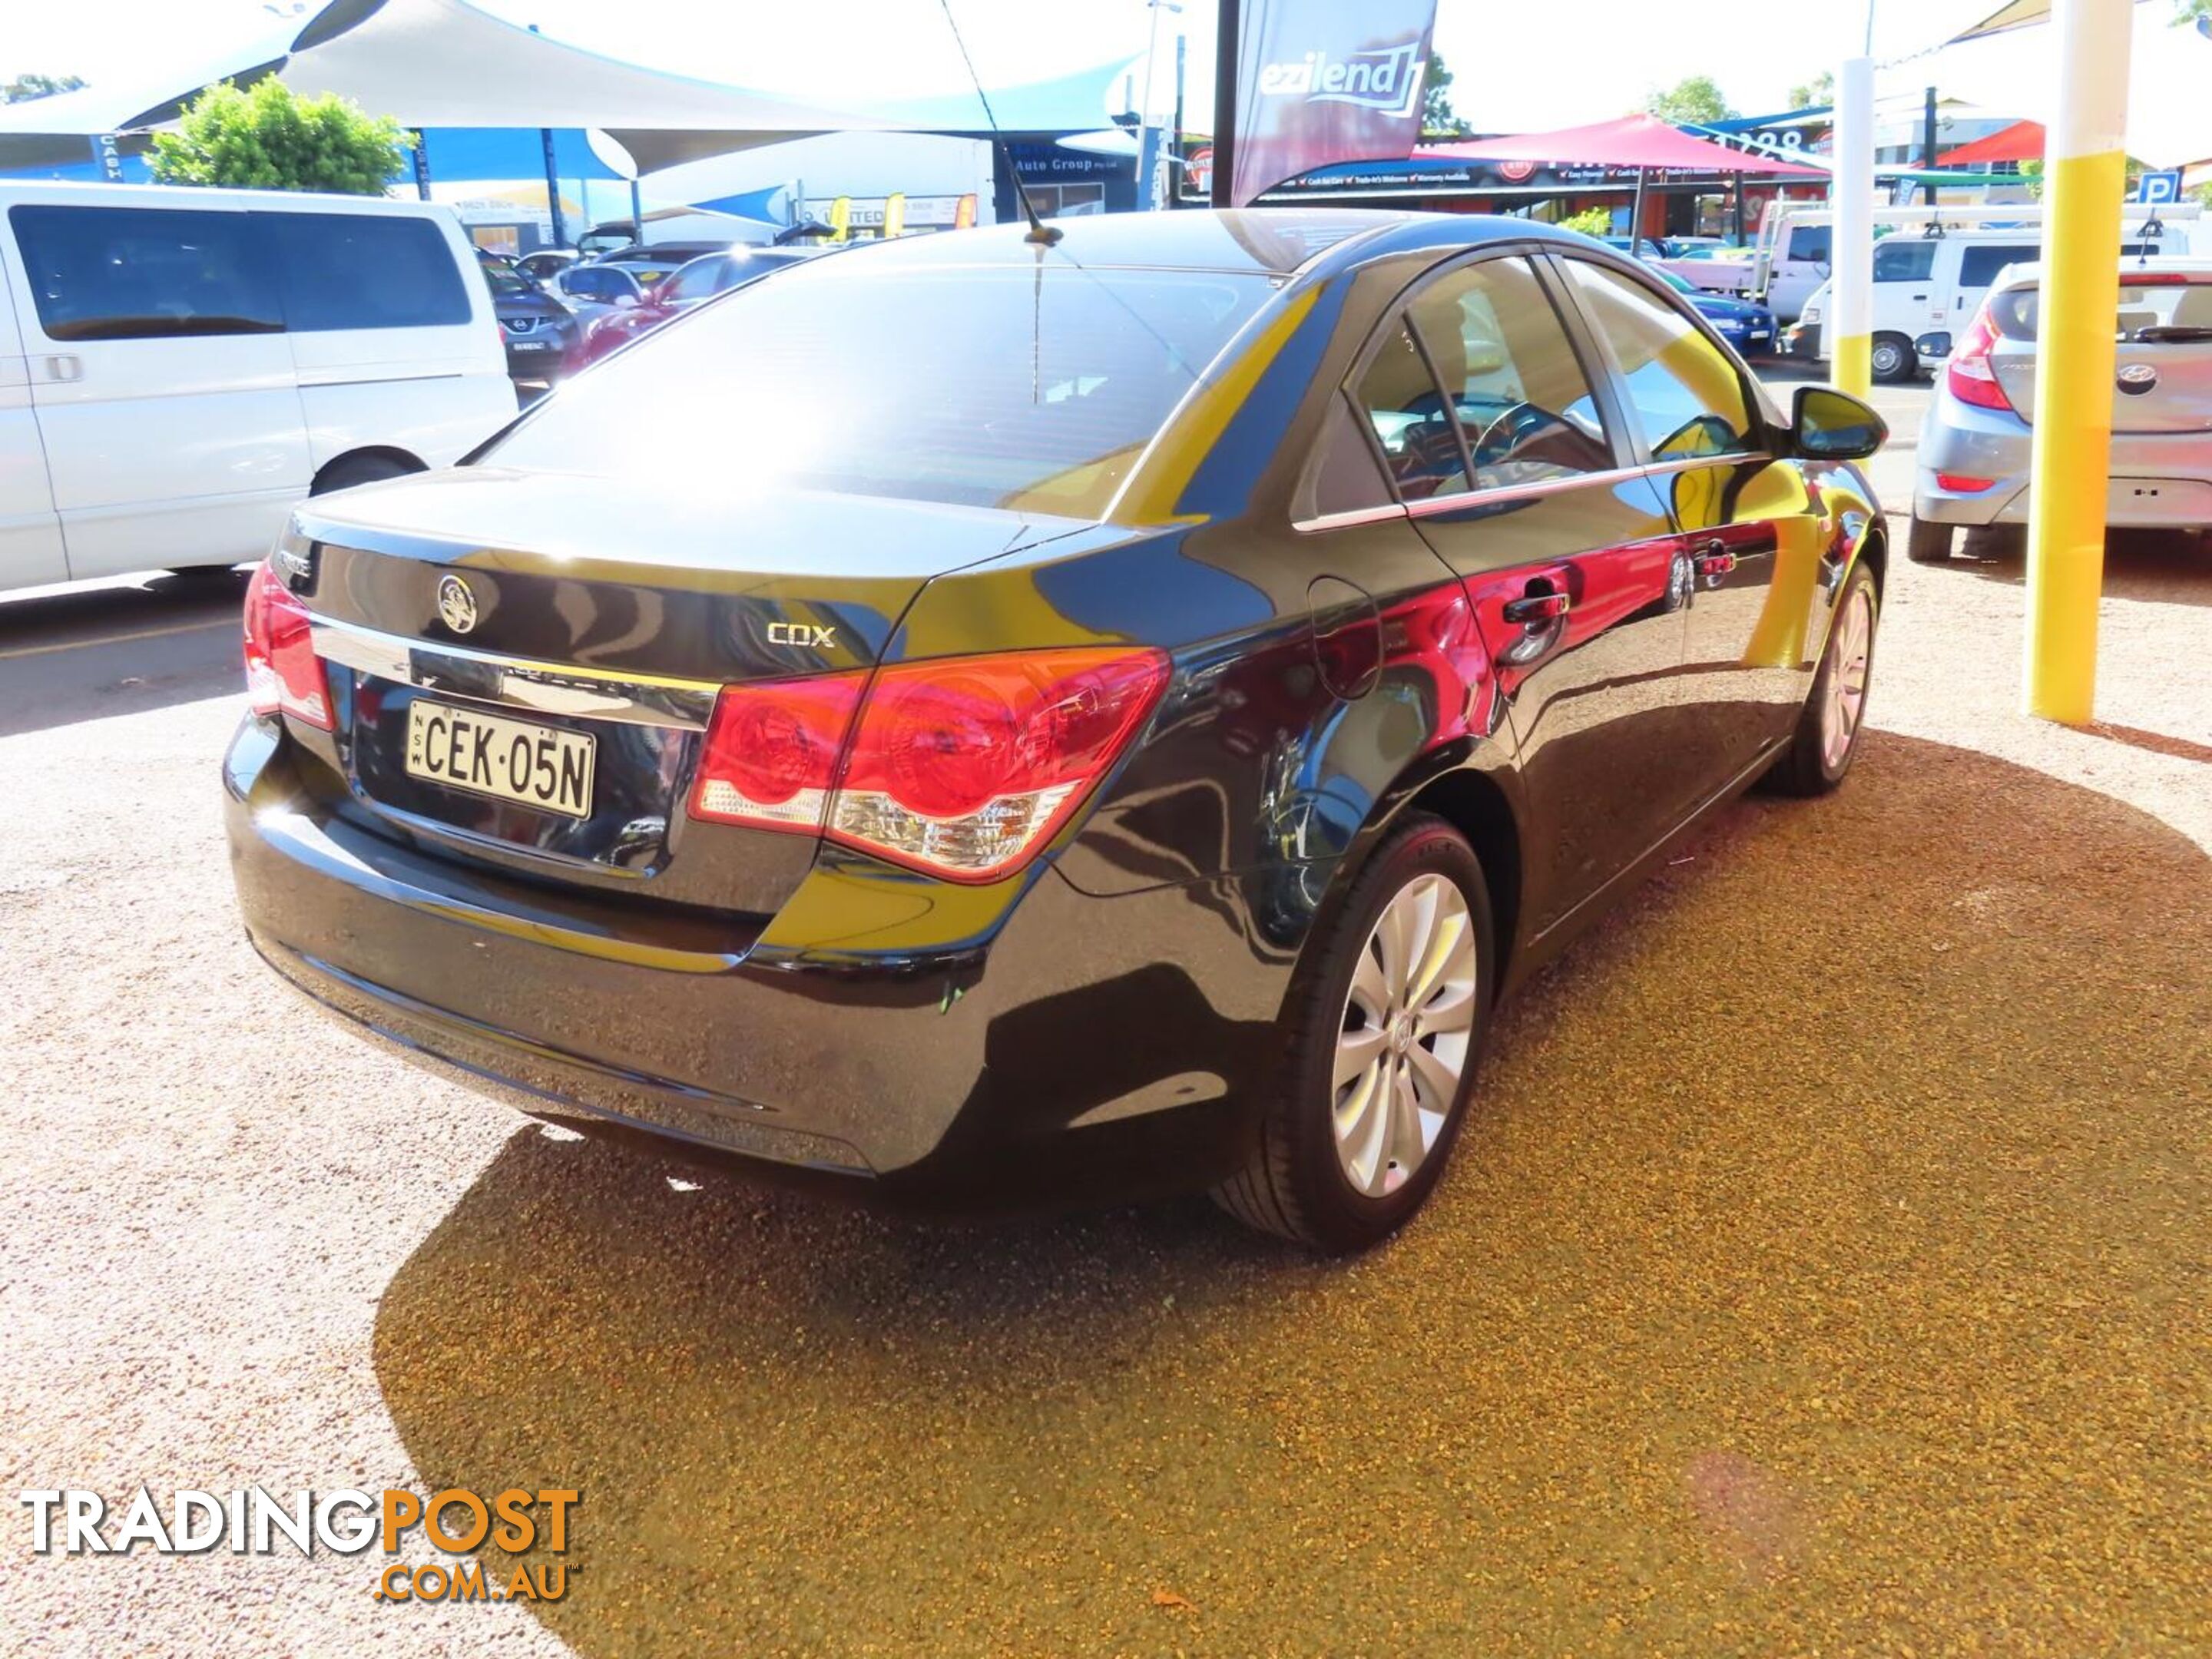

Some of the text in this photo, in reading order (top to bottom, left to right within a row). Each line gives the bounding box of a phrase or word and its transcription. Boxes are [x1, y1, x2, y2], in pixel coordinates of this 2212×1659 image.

[1260, 51, 1399, 95] ezilend
[1016, 159, 1047, 171] Auto
[1052, 157, 1092, 171] Group
[2147, 177, 2171, 203] P
[768, 623, 836, 648] CDX
